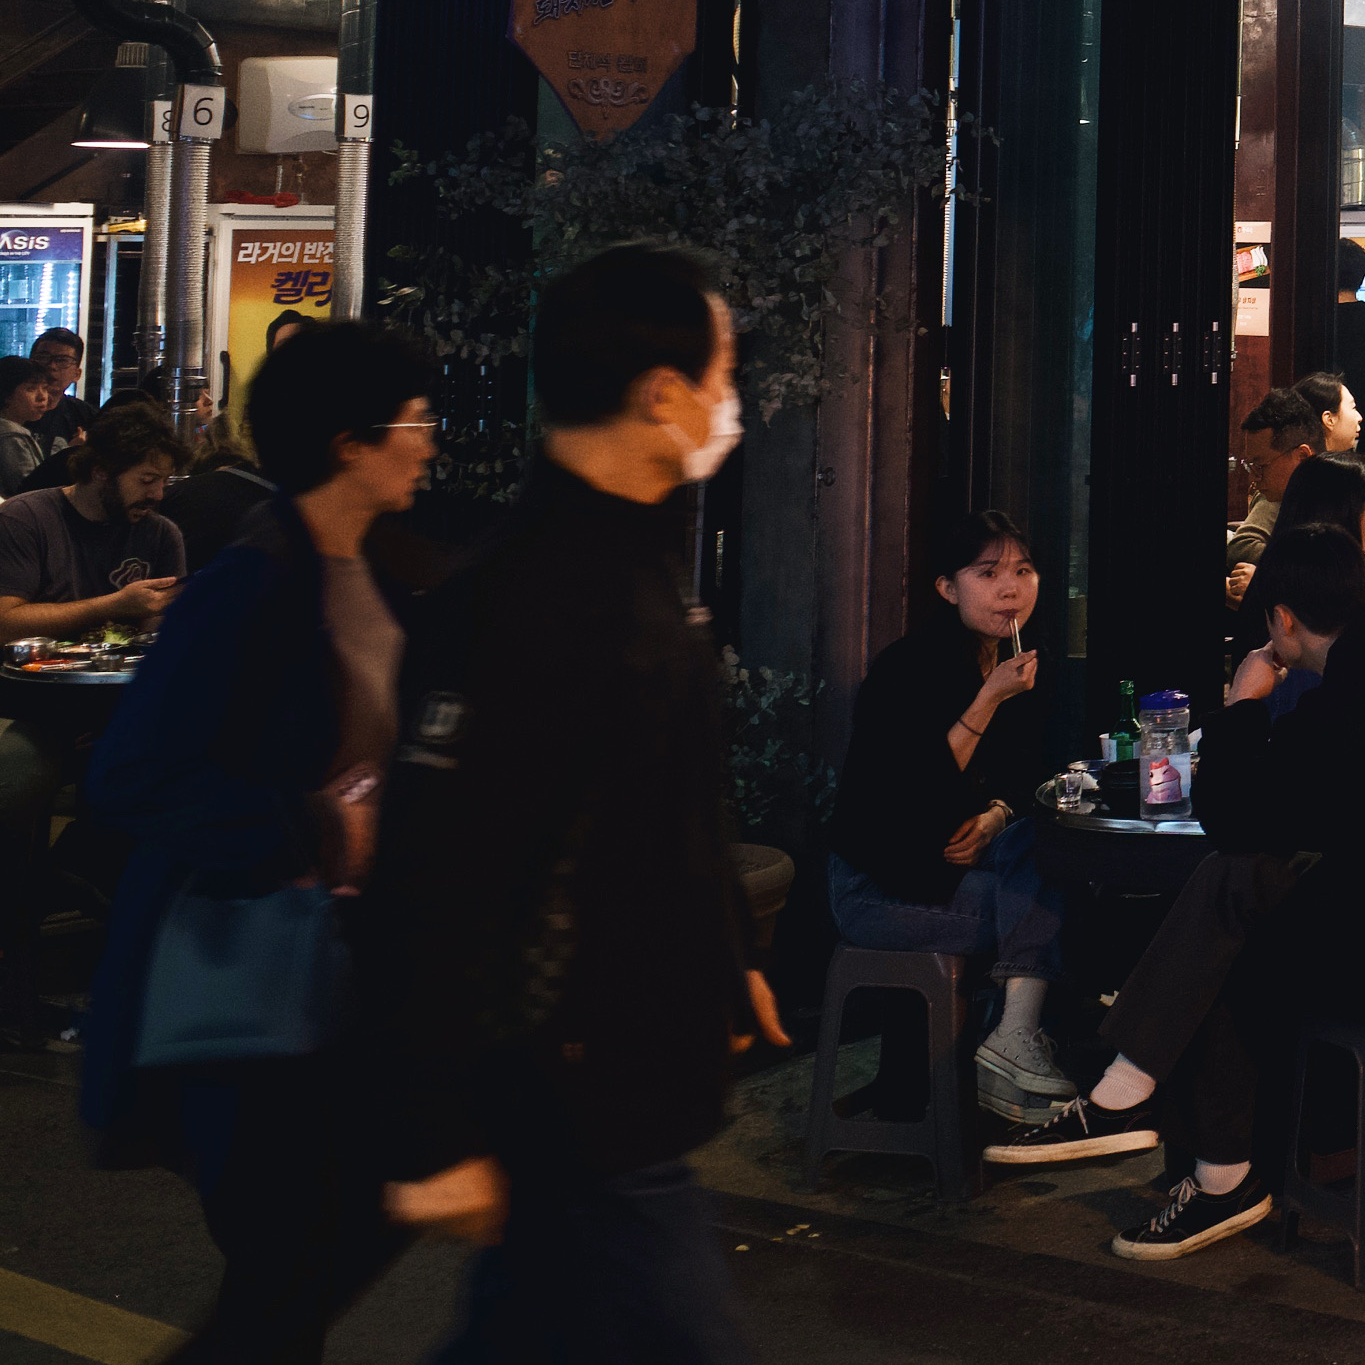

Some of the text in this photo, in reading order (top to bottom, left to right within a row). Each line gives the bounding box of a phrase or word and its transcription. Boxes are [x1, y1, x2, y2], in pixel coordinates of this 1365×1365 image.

[193, 97, 214, 126] 6
[353, 104, 370, 128] 9
[237, 241, 302, 264] 라거의
